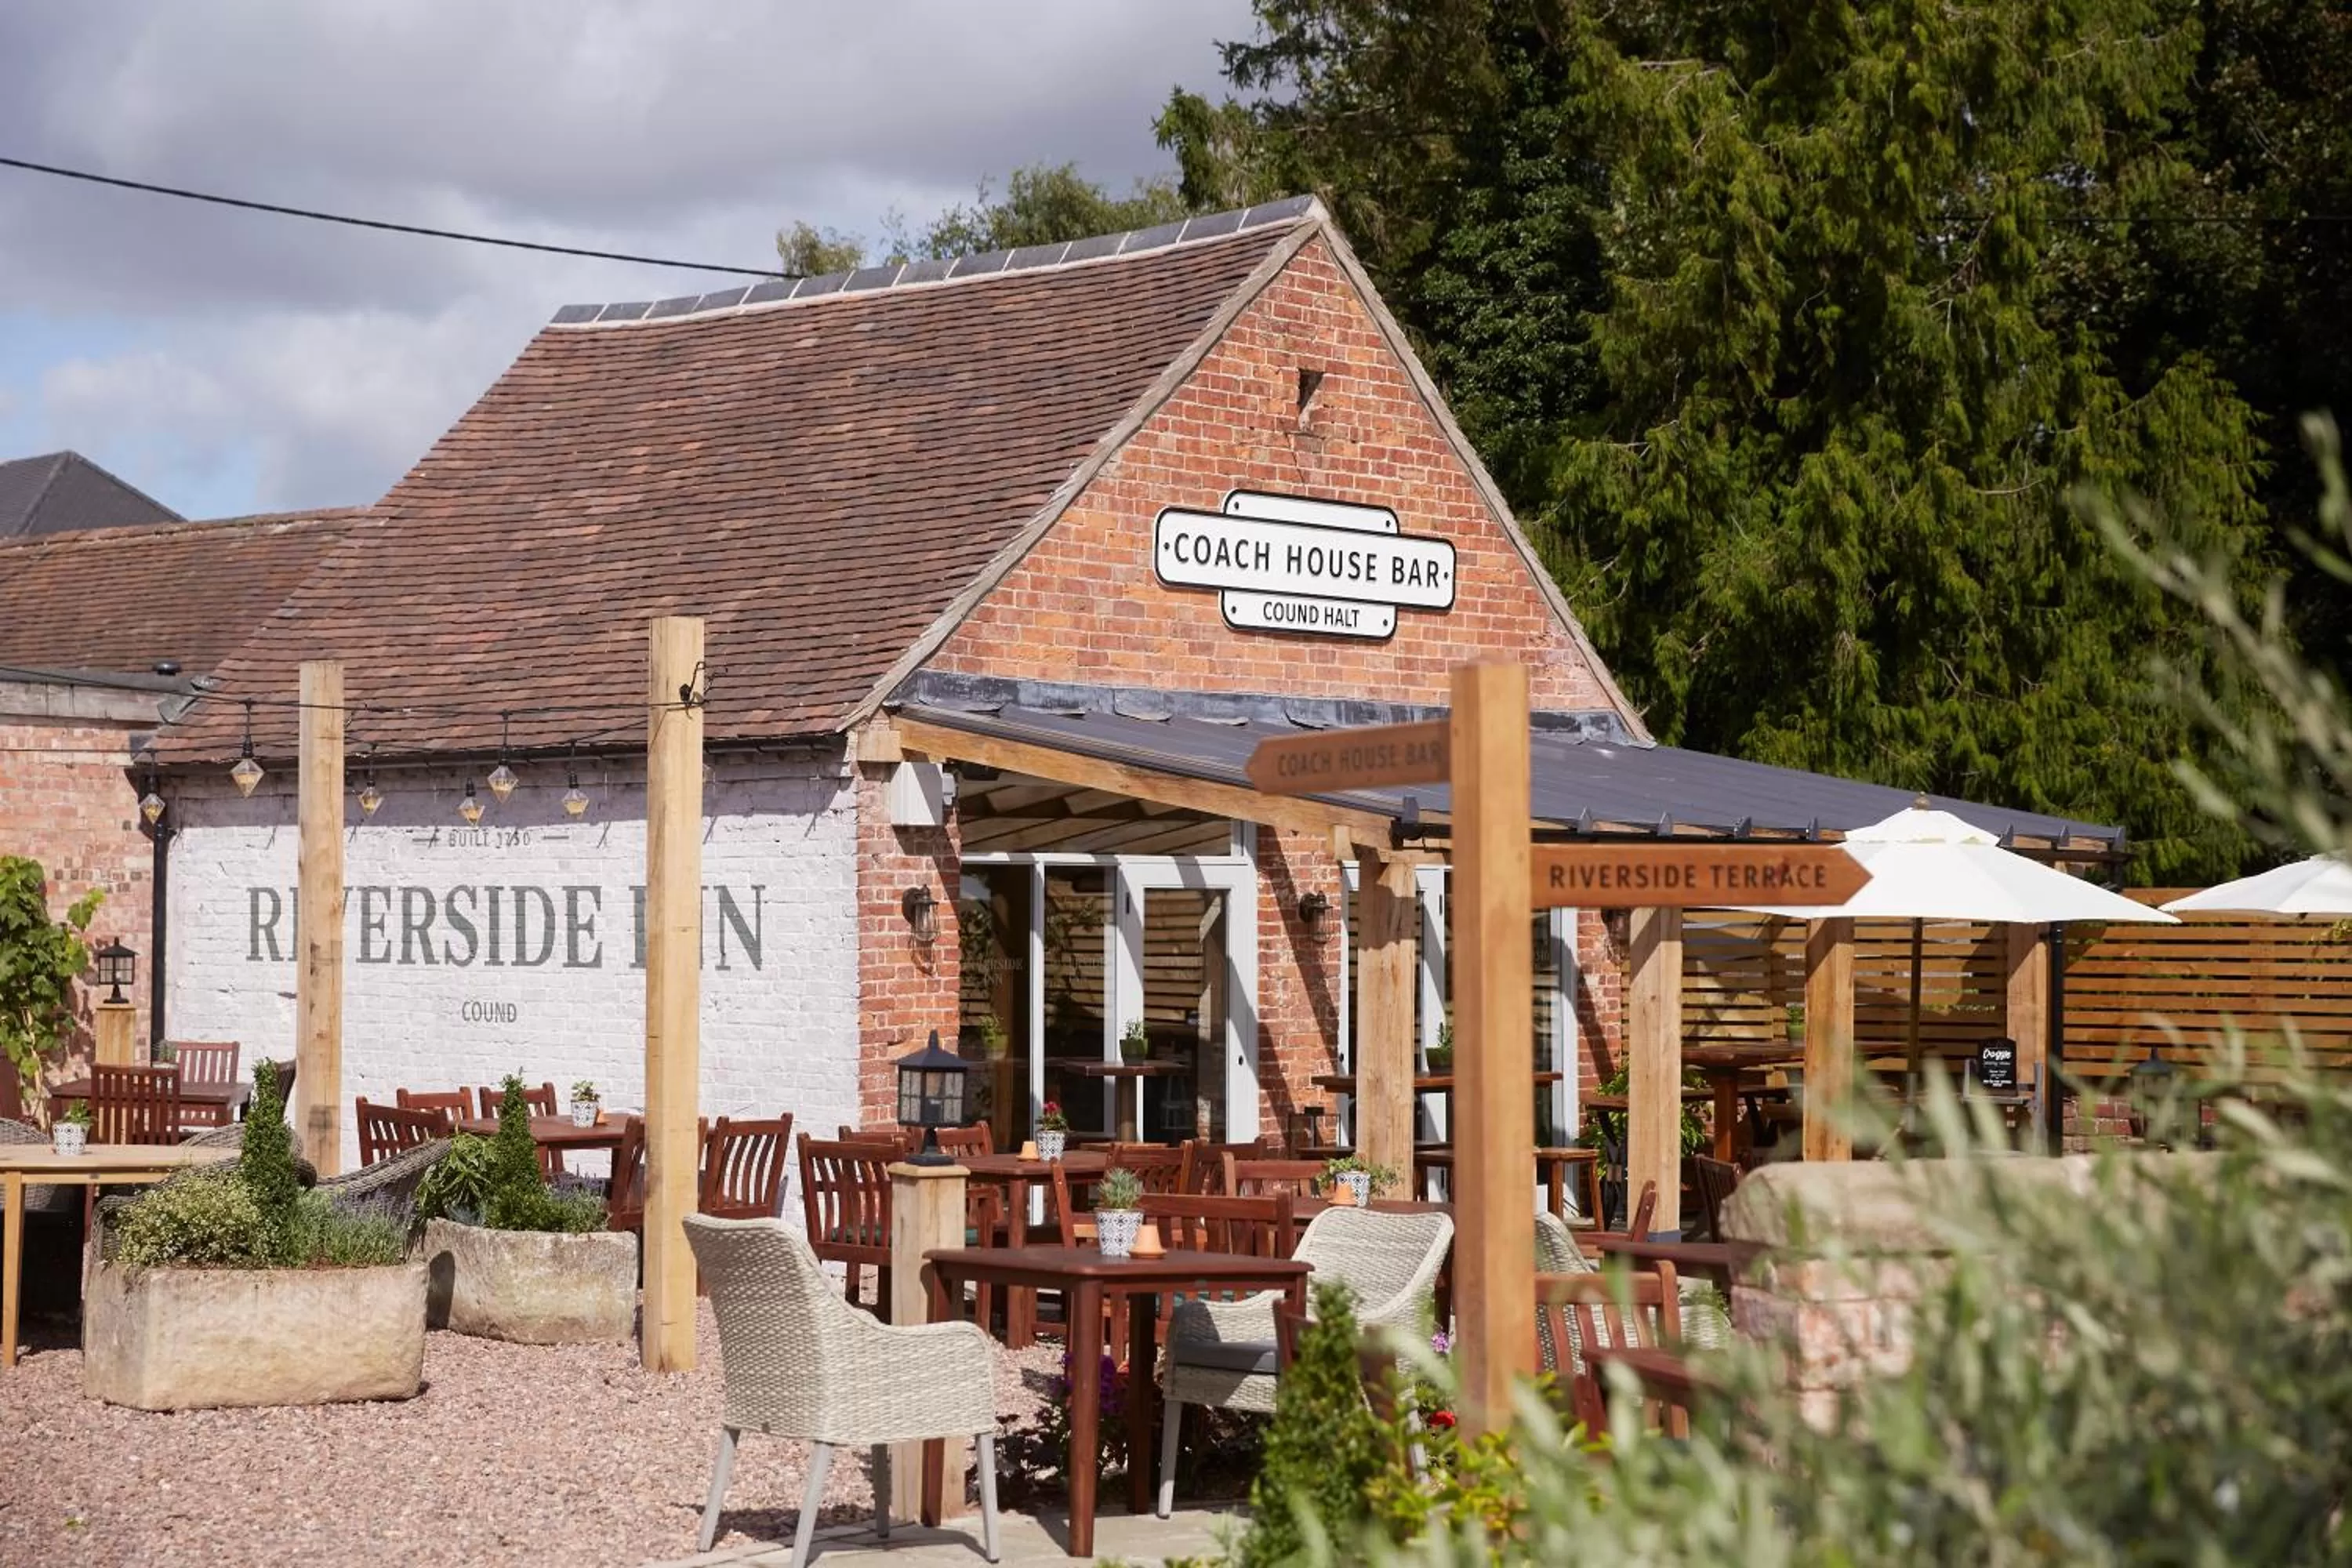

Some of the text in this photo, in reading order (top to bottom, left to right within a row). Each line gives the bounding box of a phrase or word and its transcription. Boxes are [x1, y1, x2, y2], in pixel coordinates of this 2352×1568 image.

[1174, 532, 1440, 589] COACH HOUSE BAR
[1263, 601, 1361, 628] COUND HALT
[1277, 740, 1443, 776] COACH HOUSE BAR
[448, 832, 489, 847] BUILT
[1550, 865, 1826, 888] RIVERSIDE TERRACE
[245, 884, 766, 971] RIERSIDE IN
[461, 1001, 518, 1023] COUND
